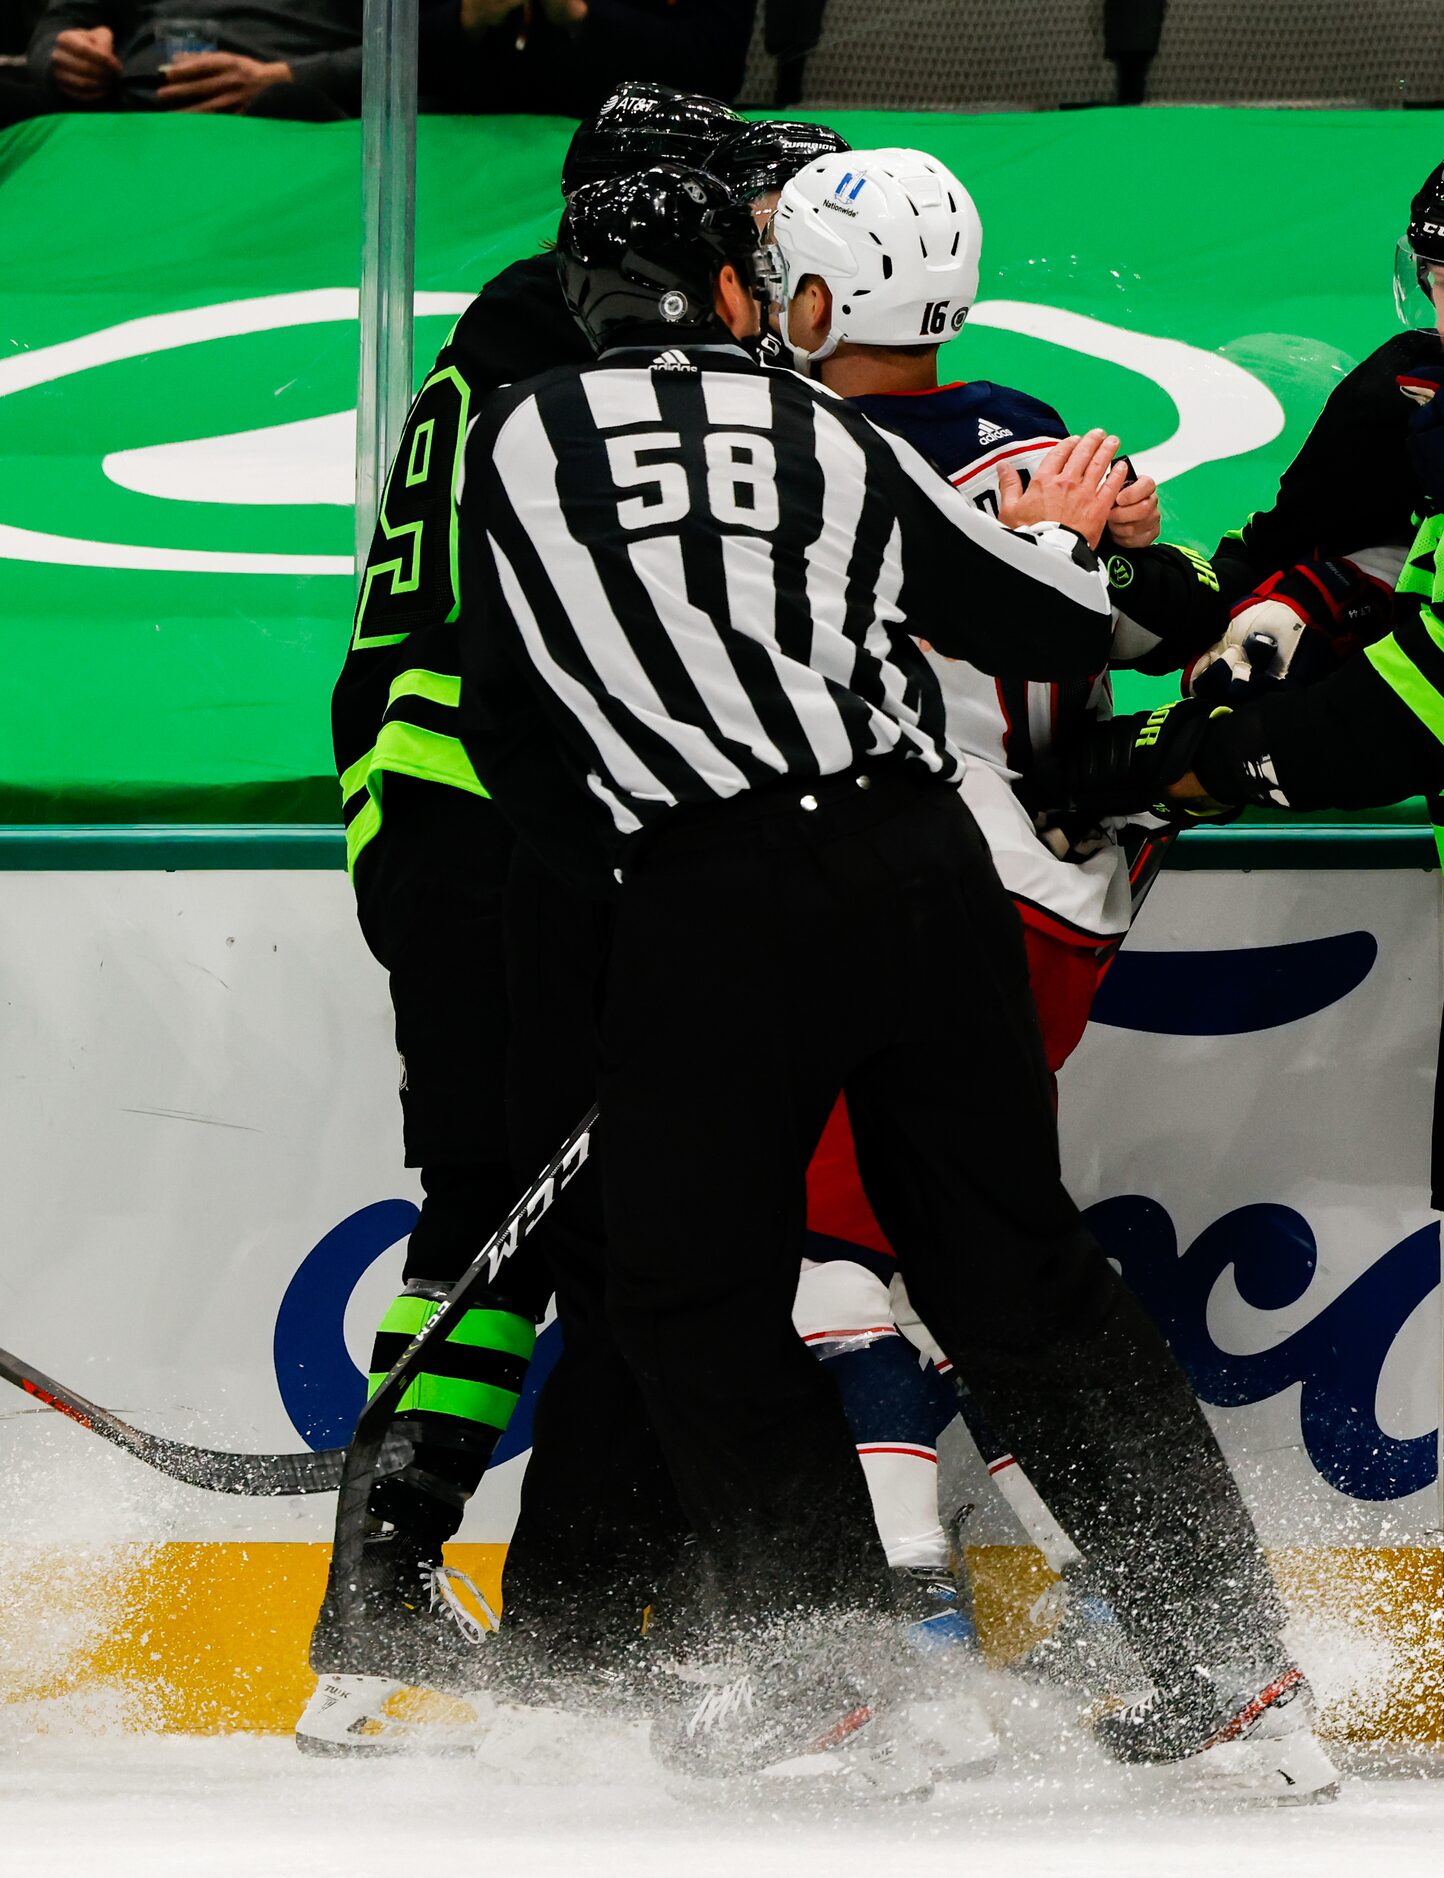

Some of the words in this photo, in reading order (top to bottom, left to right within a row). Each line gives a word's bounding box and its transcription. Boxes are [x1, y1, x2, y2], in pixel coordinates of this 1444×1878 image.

[617, 97, 657, 113] AT&T
[823, 198, 857, 219] Nationwide
[919, 301, 950, 336] 16
[979, 428, 1014, 446] adidas
[604, 432, 780, 533] 58
[487, 1132, 590, 1285] CCM
[415, 1300, 451, 1341] CCM
